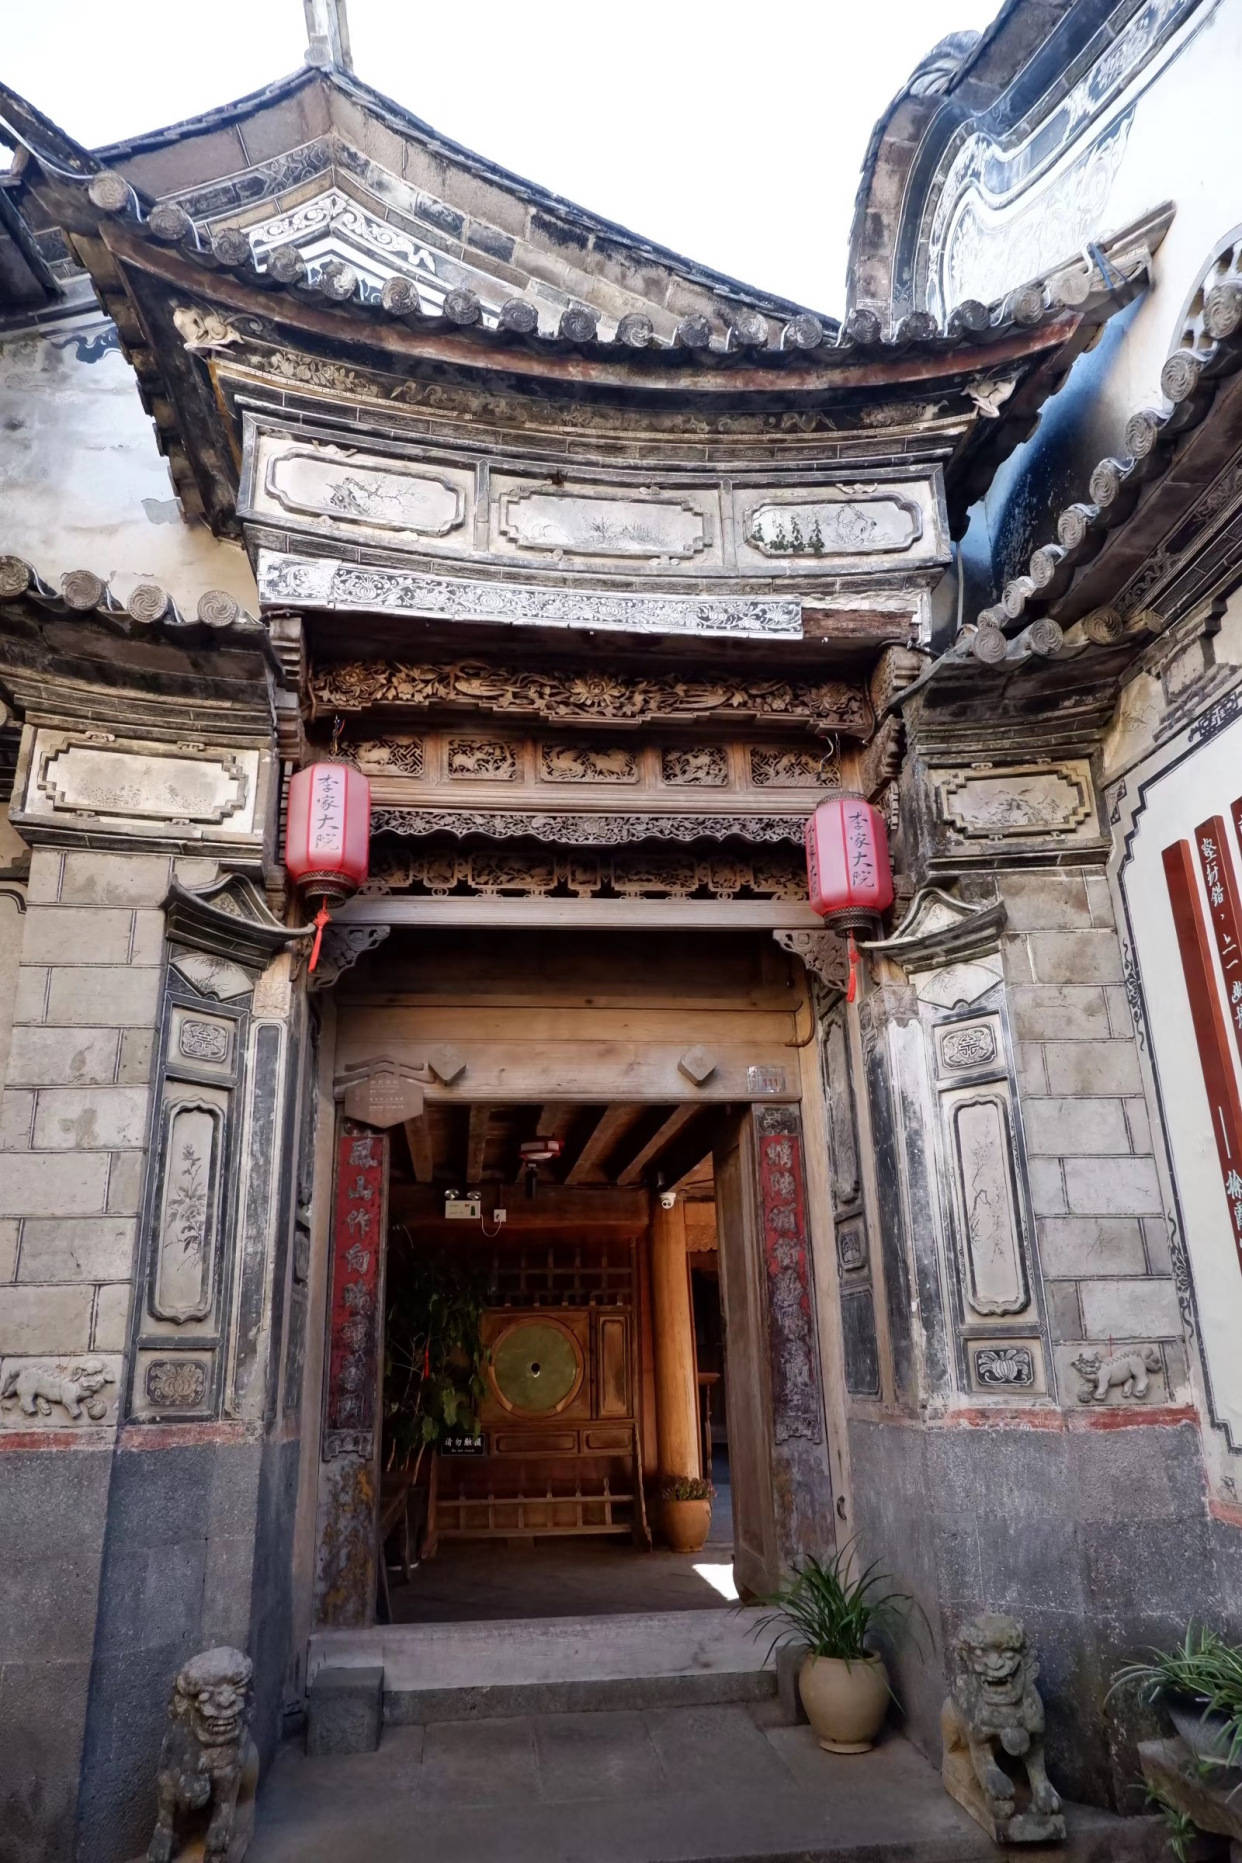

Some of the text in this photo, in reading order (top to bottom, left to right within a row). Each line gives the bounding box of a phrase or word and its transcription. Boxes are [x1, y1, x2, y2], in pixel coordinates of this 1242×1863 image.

[316, 774, 340, 850] 李家大院
[848, 811, 875, 888] 李家大院
